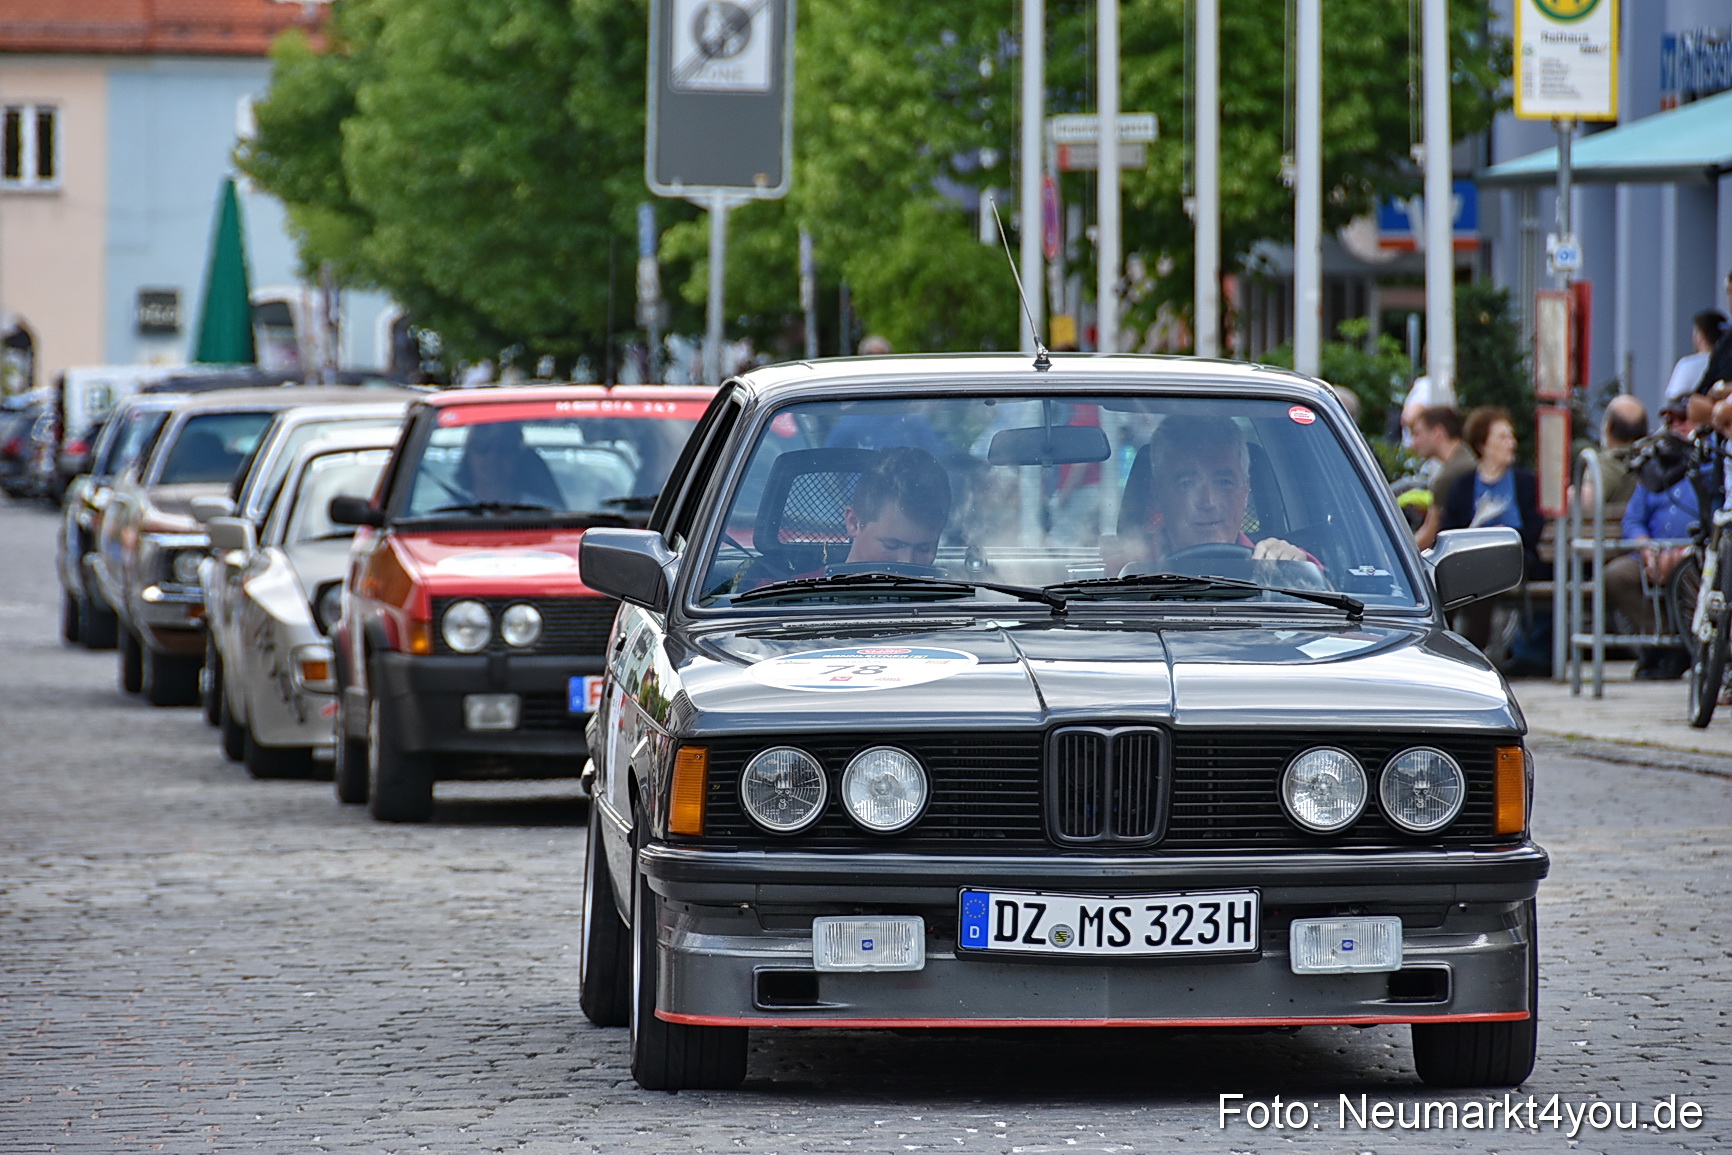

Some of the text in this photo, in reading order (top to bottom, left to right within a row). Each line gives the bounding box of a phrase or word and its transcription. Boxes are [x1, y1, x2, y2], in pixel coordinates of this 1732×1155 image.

[819, 664, 888, 675] 78
[993, 899, 1252, 947] DZ MS 323H
[969, 925, 980, 938] D
